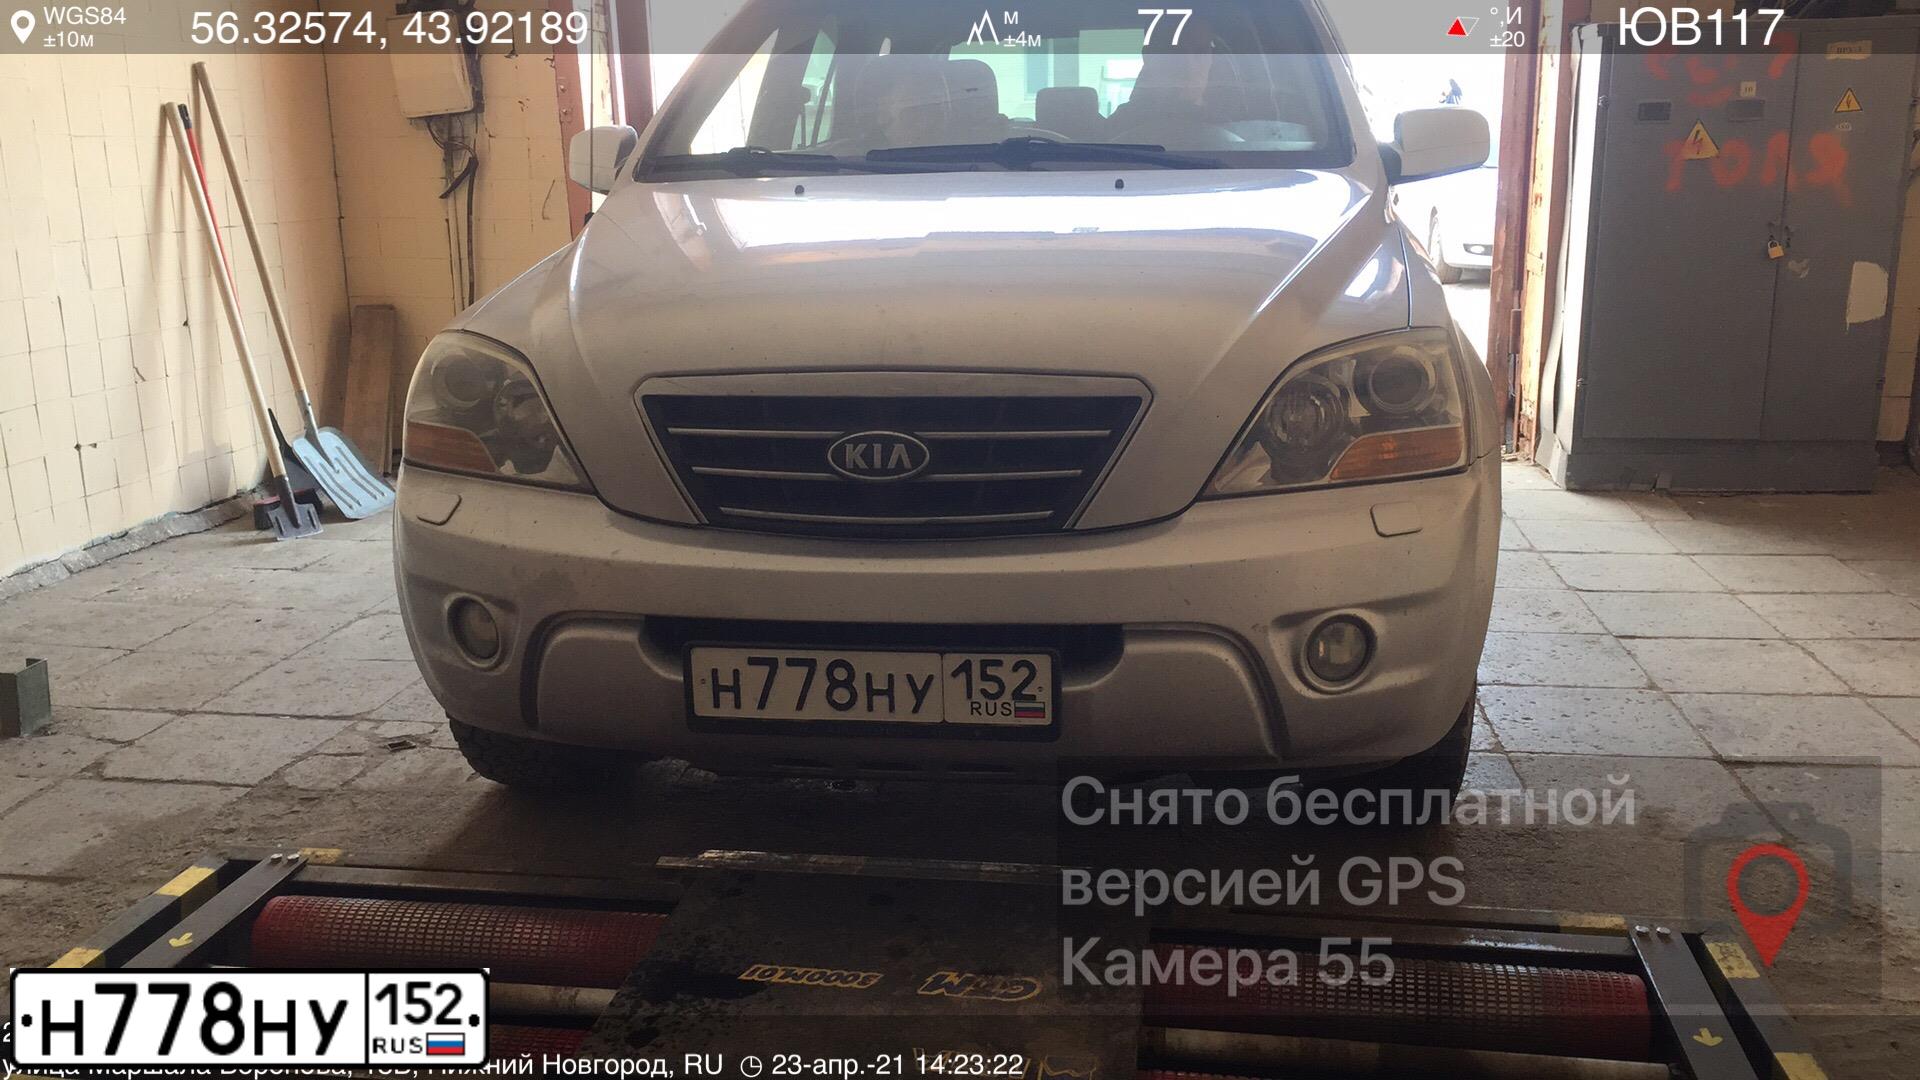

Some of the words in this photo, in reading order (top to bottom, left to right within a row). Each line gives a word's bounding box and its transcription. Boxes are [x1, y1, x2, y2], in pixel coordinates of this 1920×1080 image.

[845, 443, 913, 470] KIA
[951, 658, 1038, 702] 152
[969, 701, 1013, 718] RUS
